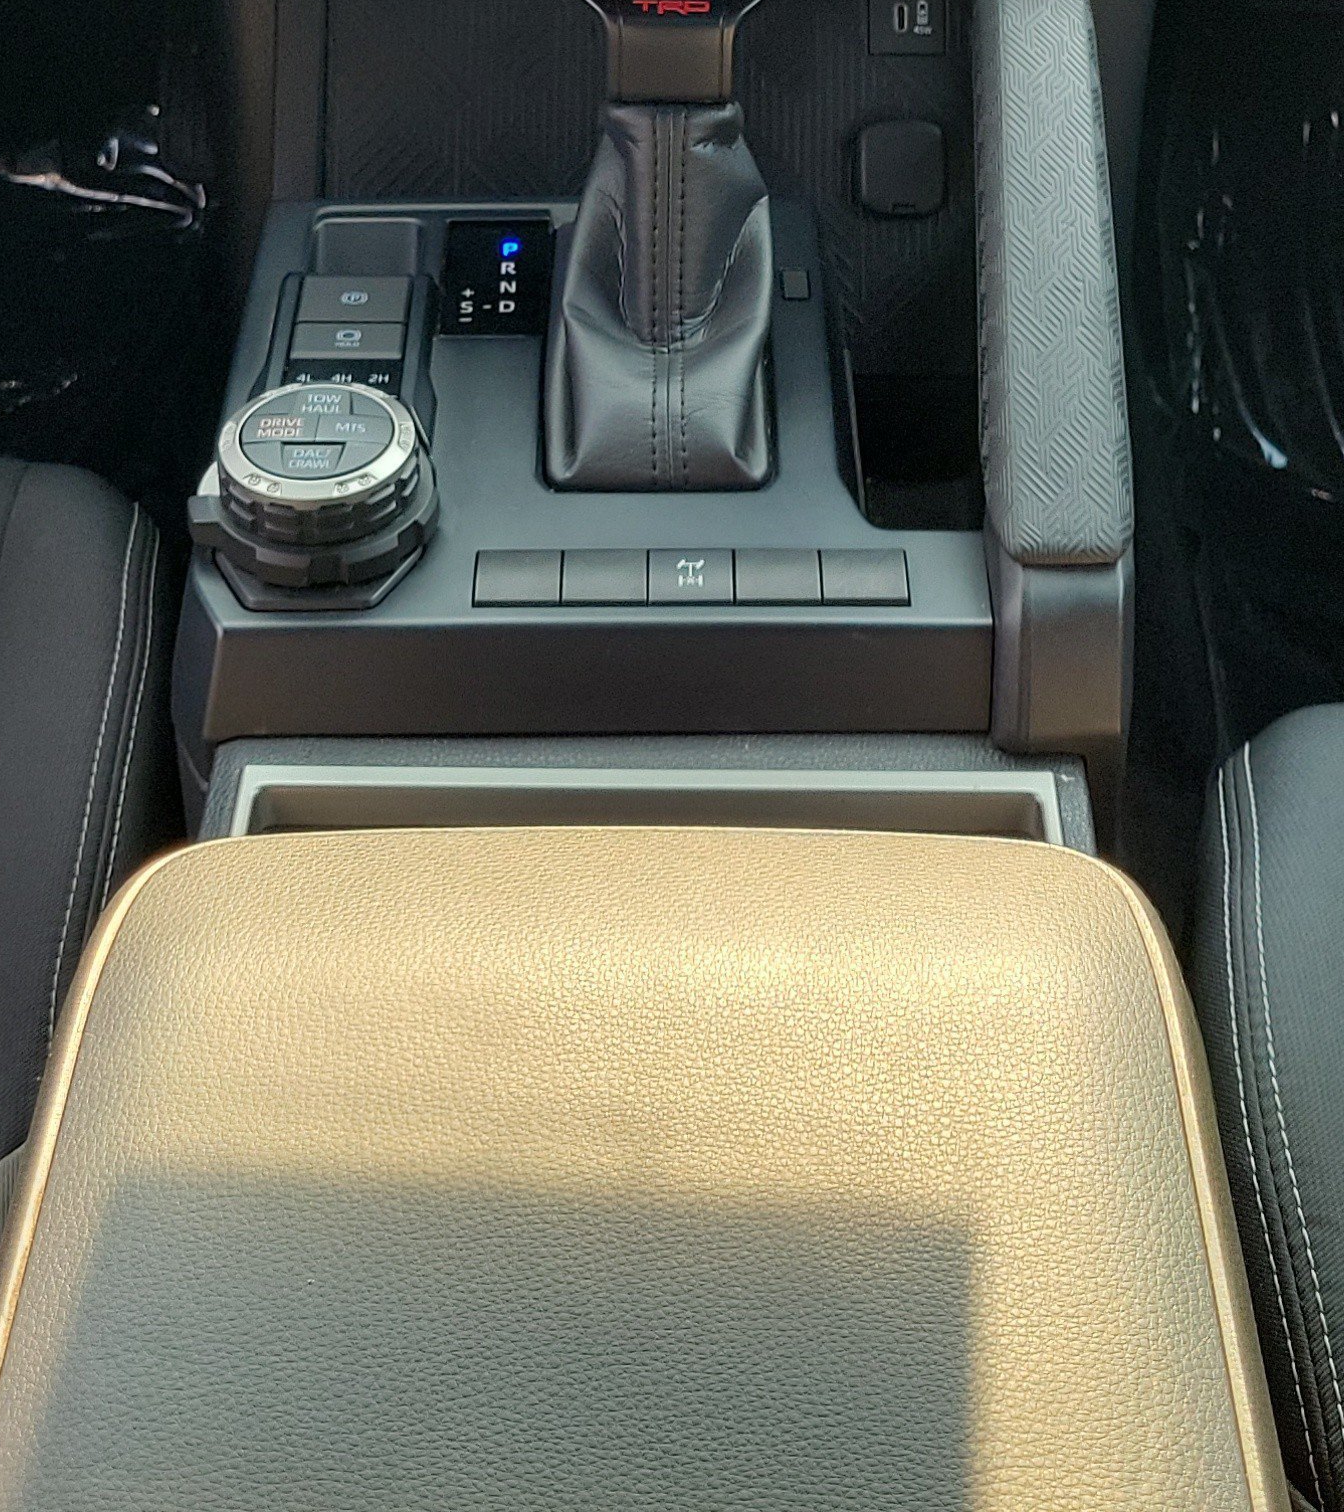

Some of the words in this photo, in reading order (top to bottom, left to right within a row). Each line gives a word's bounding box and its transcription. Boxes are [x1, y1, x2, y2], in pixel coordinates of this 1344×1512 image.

[632, 0, 711, 16] TRD
[502, 242, 519, 257] P
[501, 261, 517, 275] R
[499, 280, 517, 294] N
[459, 300, 474, 314] S
[498, 300, 516, 313] D
[331, 373, 353, 384] 4H
[367, 373, 390, 384] 2H
[306, 393, 342, 404] TOW
[301, 404, 341, 414] HAUL
[260, 418, 304, 428] DRIVE
[335, 422, 366, 434] MTS
[257, 428, 302, 438] MODE
[288, 459, 330, 470] CRAWL
